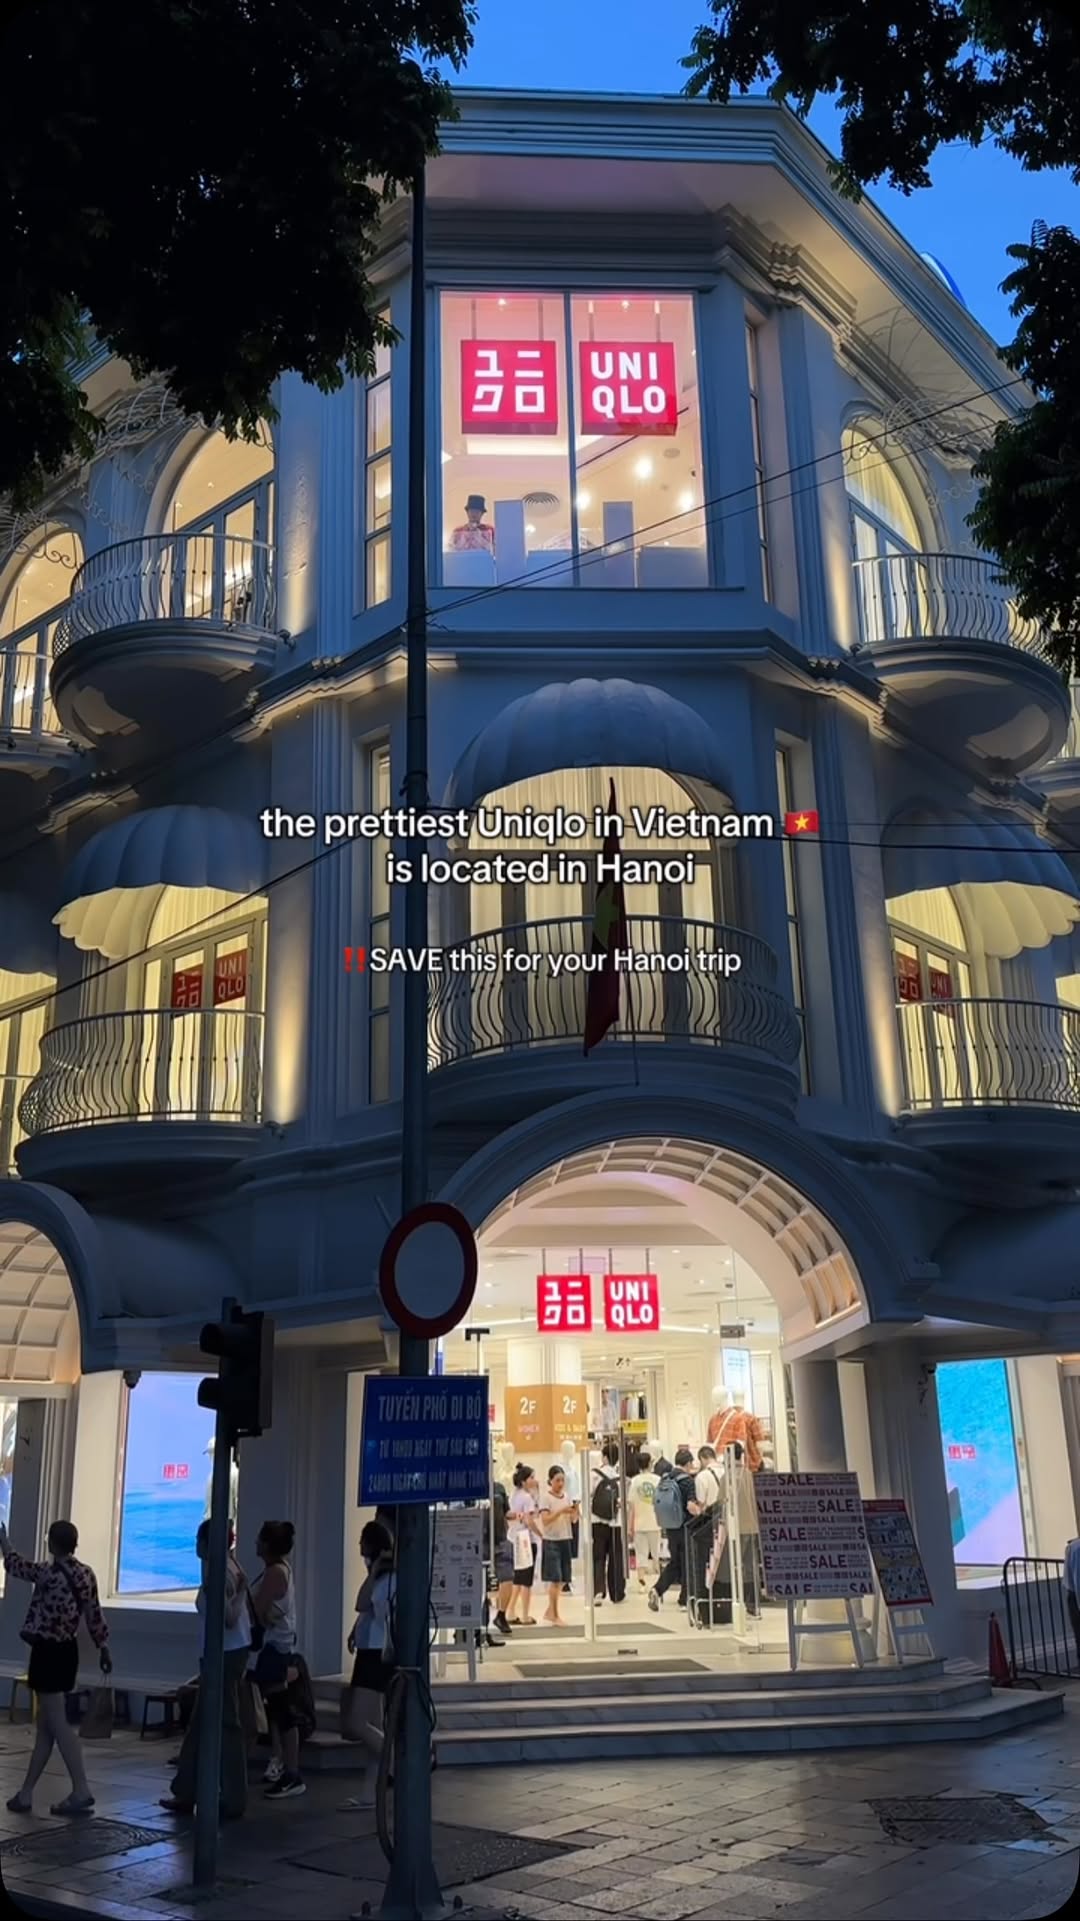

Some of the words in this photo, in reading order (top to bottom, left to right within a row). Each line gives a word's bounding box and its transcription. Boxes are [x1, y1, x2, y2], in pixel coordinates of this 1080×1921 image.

[473, 350, 544, 378] ユニ
[590, 351, 658, 380] UNI
[472, 384, 545, 413] クロ
[592, 385, 666, 419] QLO
[219, 956, 243, 977] UNI
[219, 976, 244, 1000] QLO
[610, 1280, 649, 1301] UNI
[611, 1304, 654, 1328] QLO
[519, 1396, 537, 1415] 2F
[562, 1395, 577, 1414] 2F
[777, 1474, 816, 1486] SALE
[816, 1499, 855, 1513] SALE
[769, 1527, 807, 1541] SALE
[809, 1554, 847, 1569] SALE
